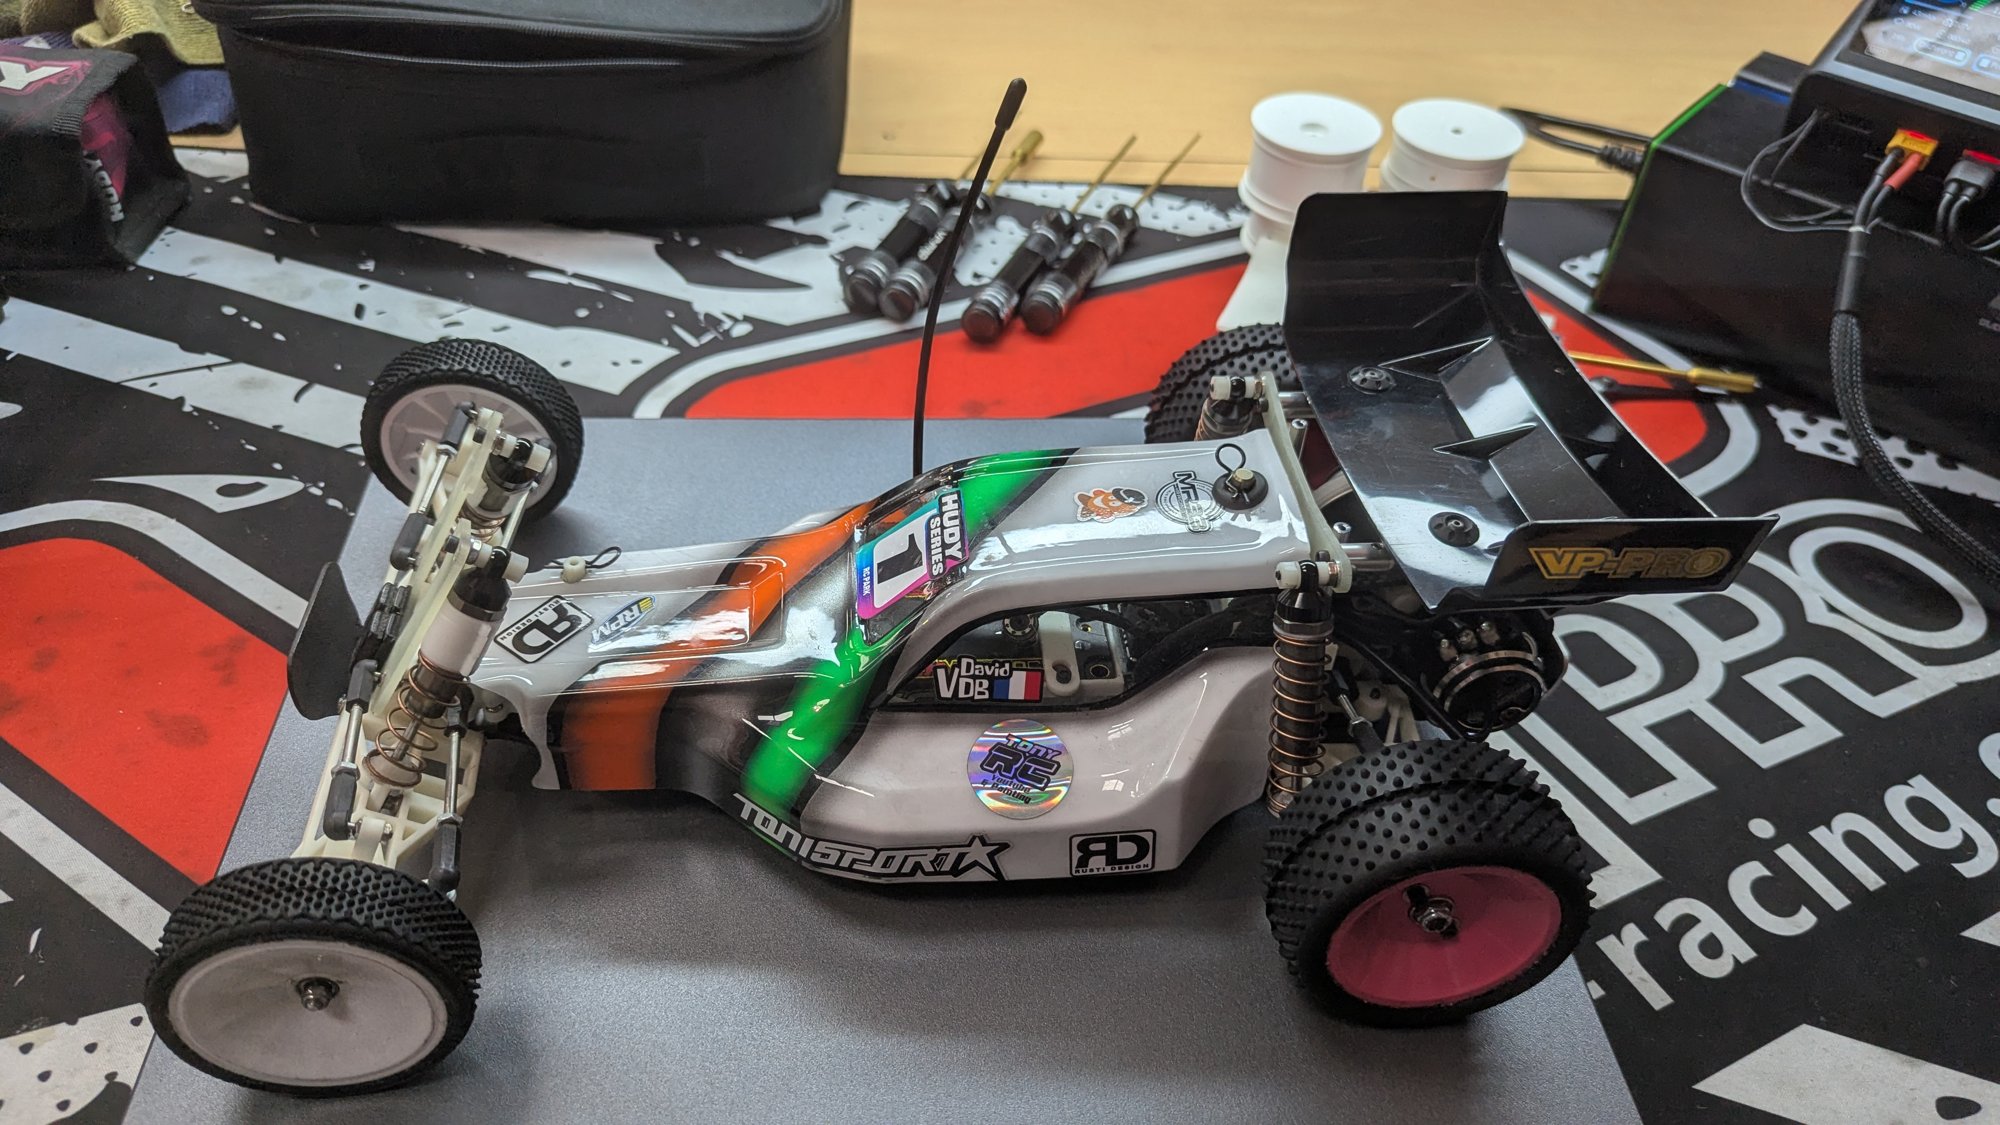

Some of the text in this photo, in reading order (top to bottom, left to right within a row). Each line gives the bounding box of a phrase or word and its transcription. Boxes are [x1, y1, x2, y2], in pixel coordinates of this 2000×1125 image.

[930, 516, 944, 576] SERIES
[941, 493, 963, 560] HUDY
[877, 533, 923, 585] 1
[1529, 547, 1731, 579] VP-PRO
[500, 599, 561, 641] RUSTI DESIGN
[591, 602, 641, 643] RPM
[937, 667, 990, 700] VDB
[961, 657, 1010, 677] David
[981, 743, 1061, 791] RC
[1074, 864, 1150, 875] RUSTI DESIGN
